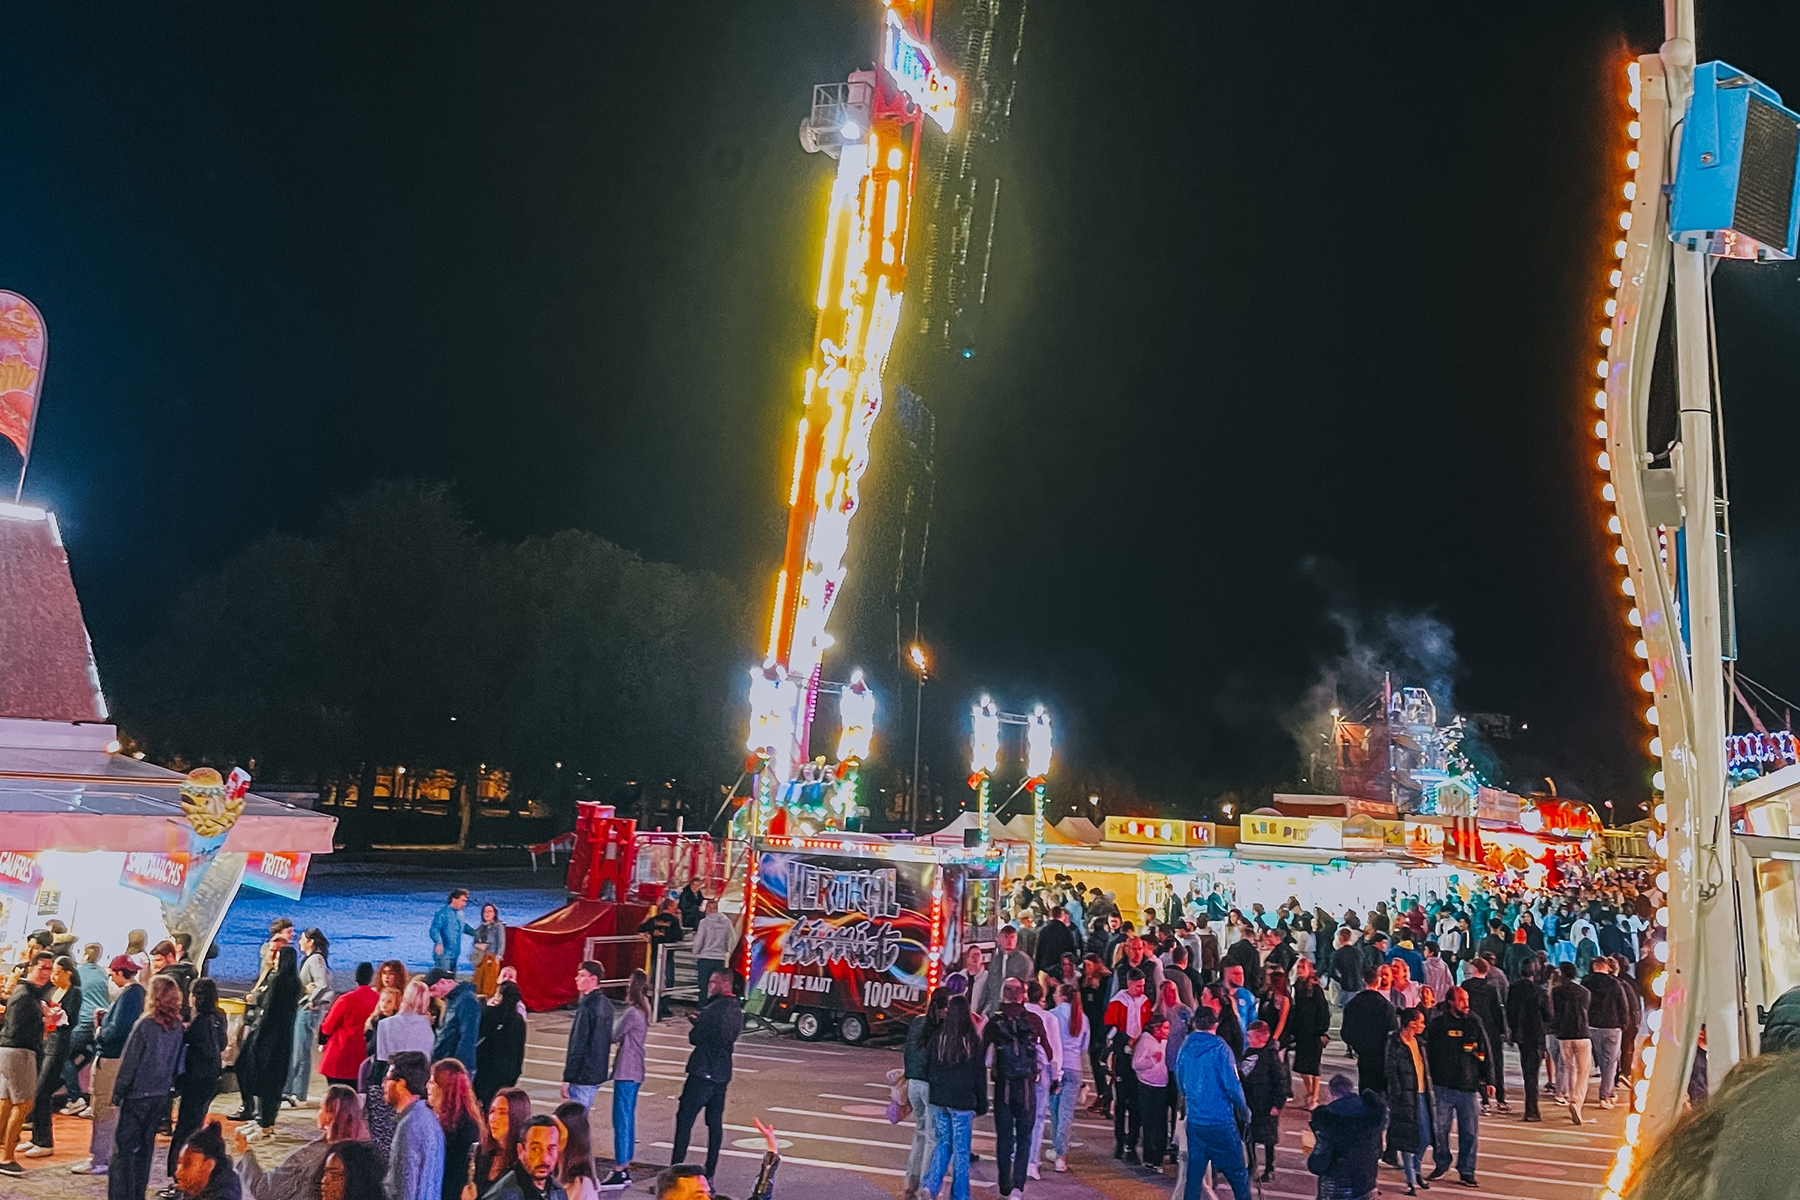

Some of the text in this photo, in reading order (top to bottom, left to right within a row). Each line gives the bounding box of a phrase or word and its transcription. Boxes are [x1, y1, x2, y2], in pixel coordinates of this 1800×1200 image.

[126, 851, 184, 887] SANDWICHS
[260, 852, 291, 880] FRITES
[756, 971, 792, 998] 40M
